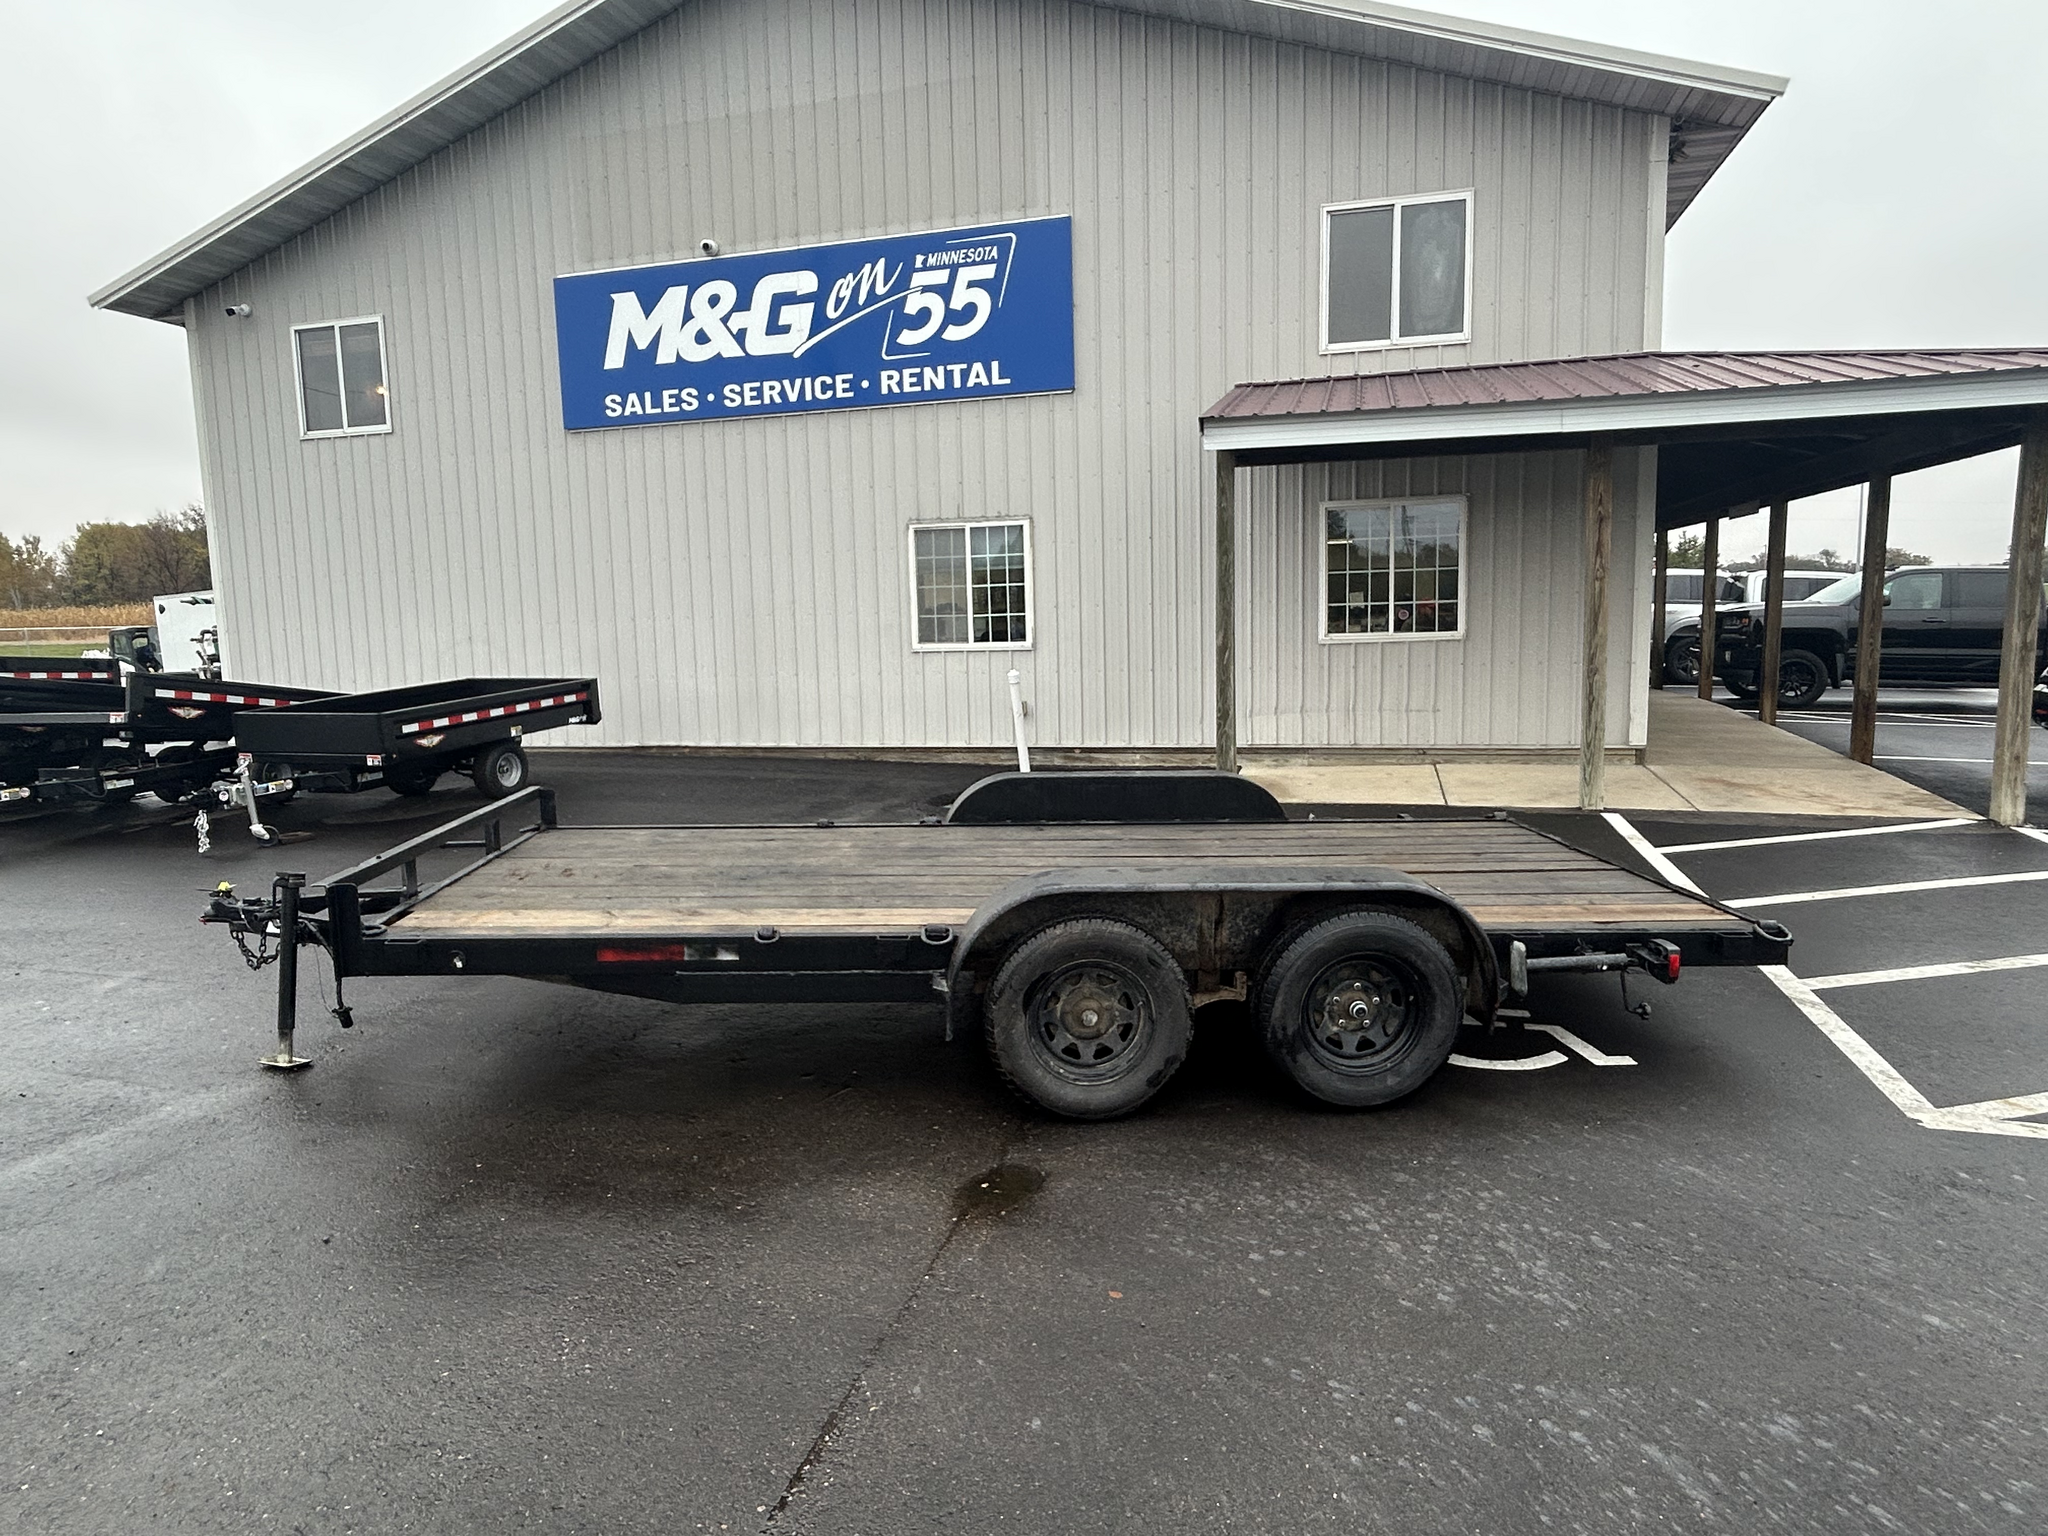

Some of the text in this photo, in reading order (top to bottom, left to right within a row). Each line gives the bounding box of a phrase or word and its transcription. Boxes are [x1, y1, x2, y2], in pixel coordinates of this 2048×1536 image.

[926, 246, 998, 267] MINNESOTA
[603, 257, 997, 370] M&G on 55
[604, 361, 1011, 418] SALES SERVICE RENTAL
